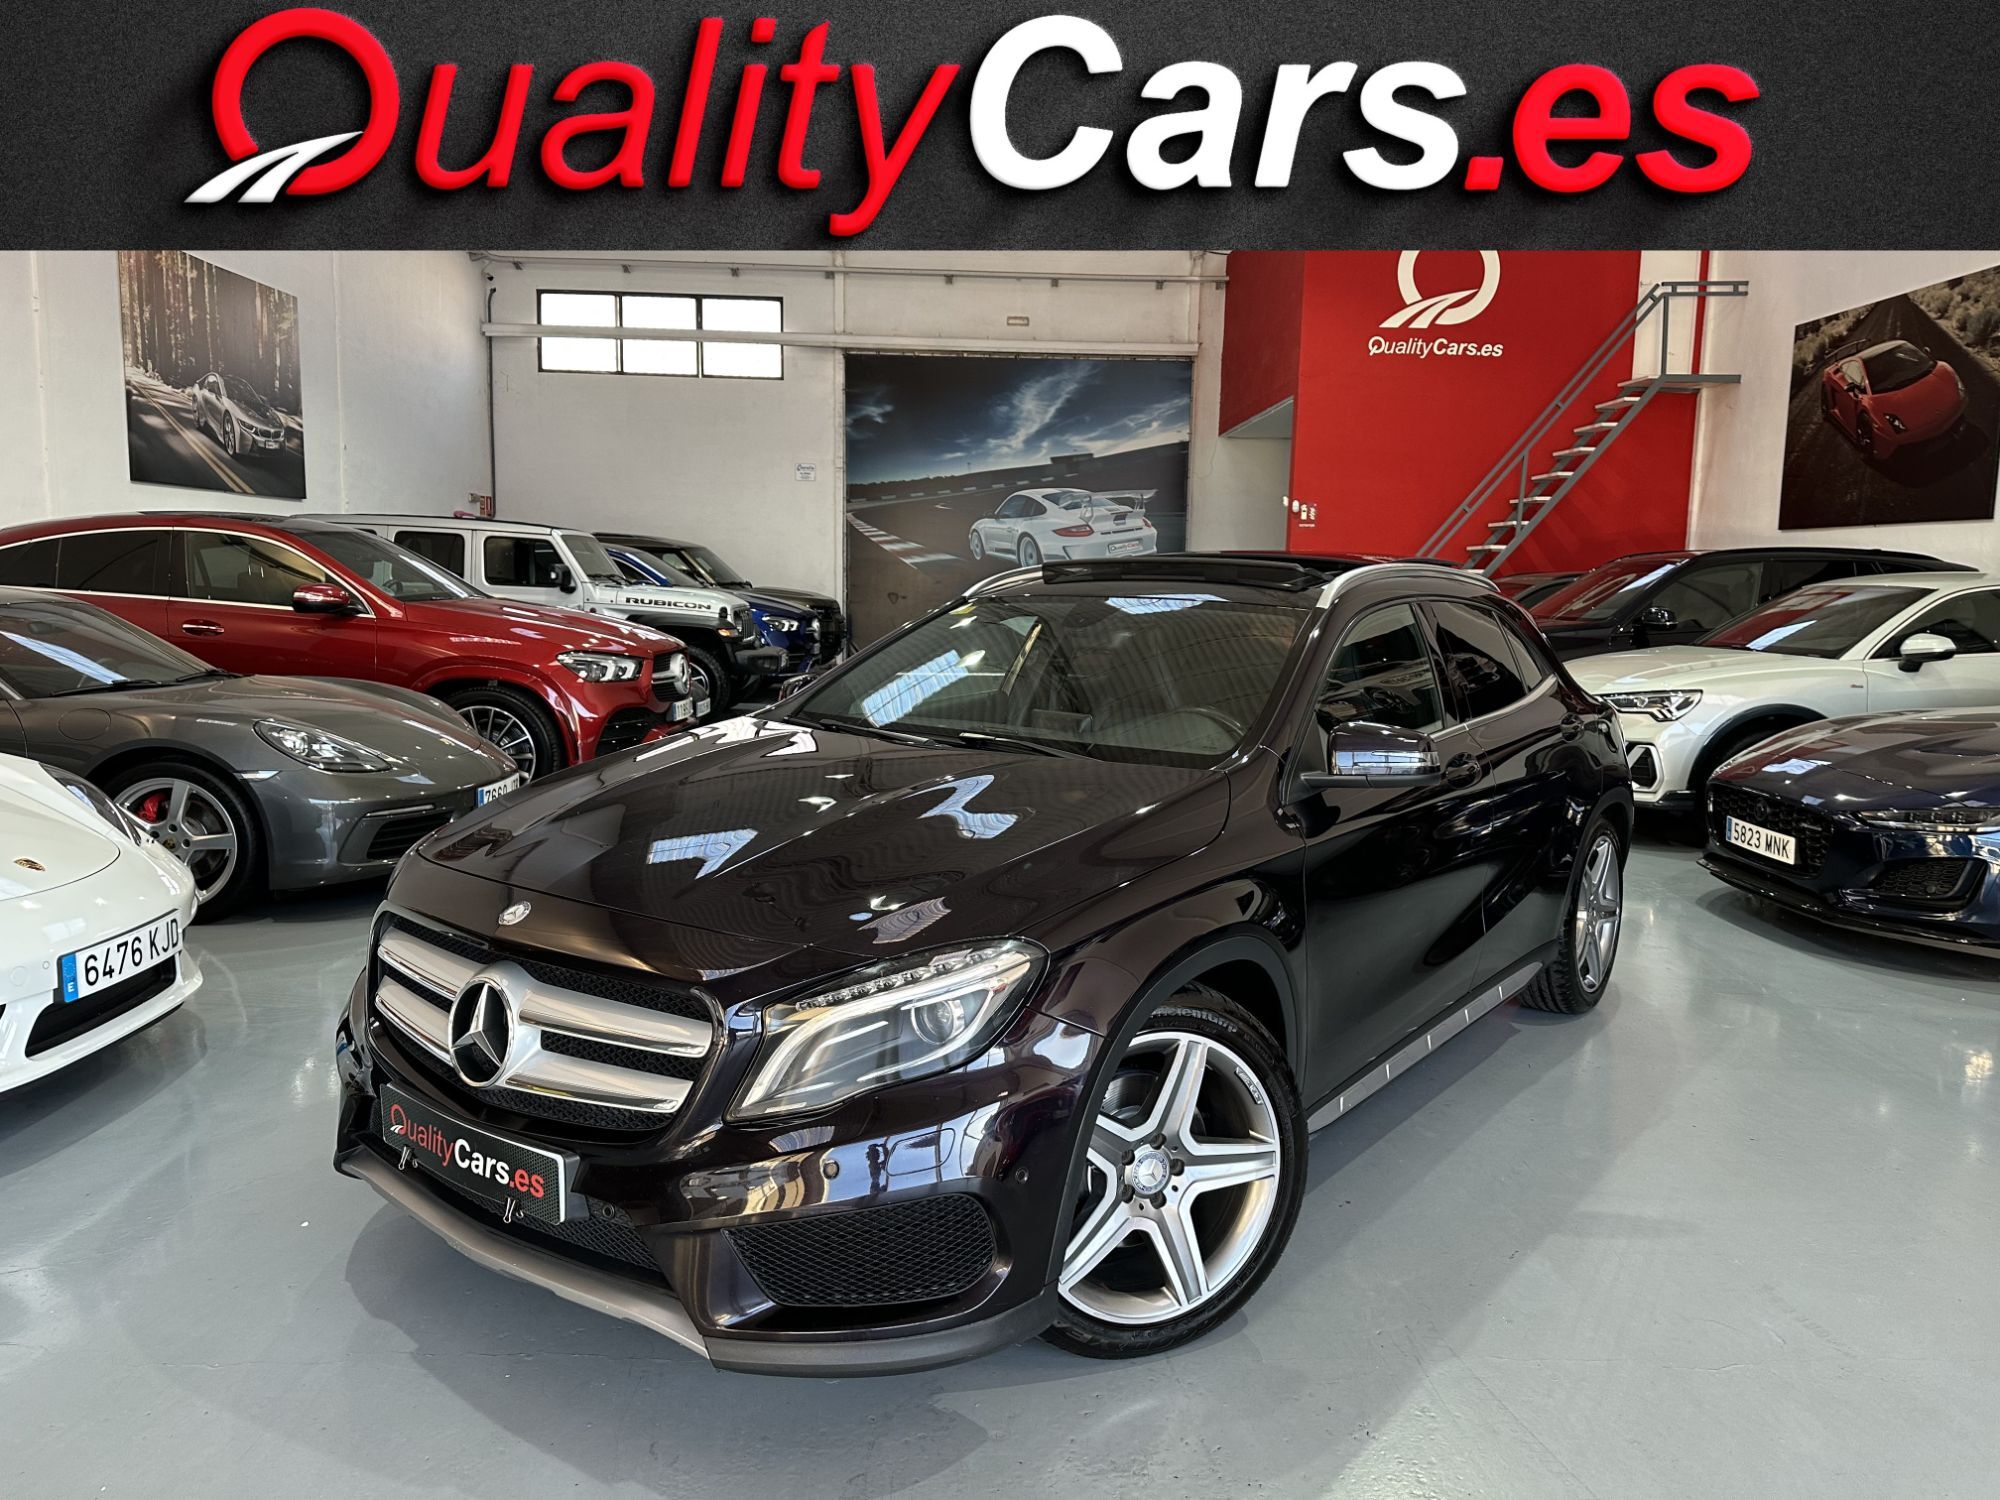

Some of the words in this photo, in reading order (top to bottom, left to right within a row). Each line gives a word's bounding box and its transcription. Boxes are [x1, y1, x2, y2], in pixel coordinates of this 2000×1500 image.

[1368, 336, 1503, 358] QualityCars.es
[626, 597, 711, 610] RUBICON
[1733, 823, 1761, 848] 5823
[1765, 833, 1790, 859] MNK
[84, 936, 143, 986] 6476
[149, 918, 179, 960] KJD
[390, 1104, 545, 1199] QualityCars.es
